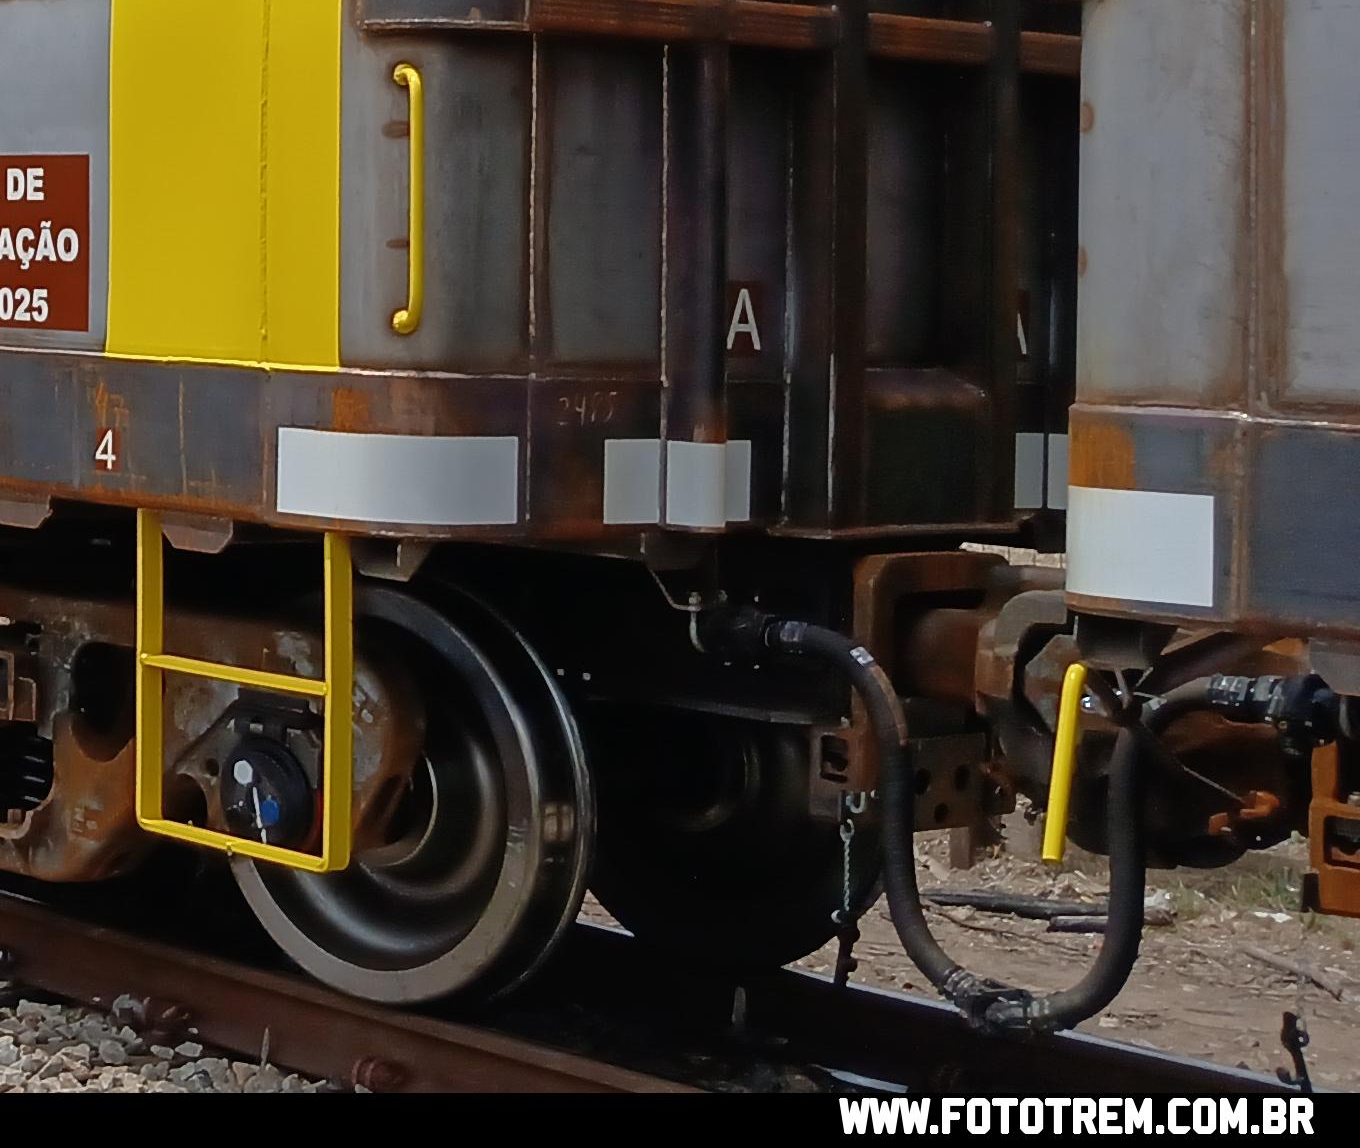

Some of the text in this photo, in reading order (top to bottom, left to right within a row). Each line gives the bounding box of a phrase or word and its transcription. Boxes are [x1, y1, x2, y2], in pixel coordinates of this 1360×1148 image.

[6, 167, 45, 201] DE
[726, 288, 761, 351] A
[95, 428, 116, 470] 4
